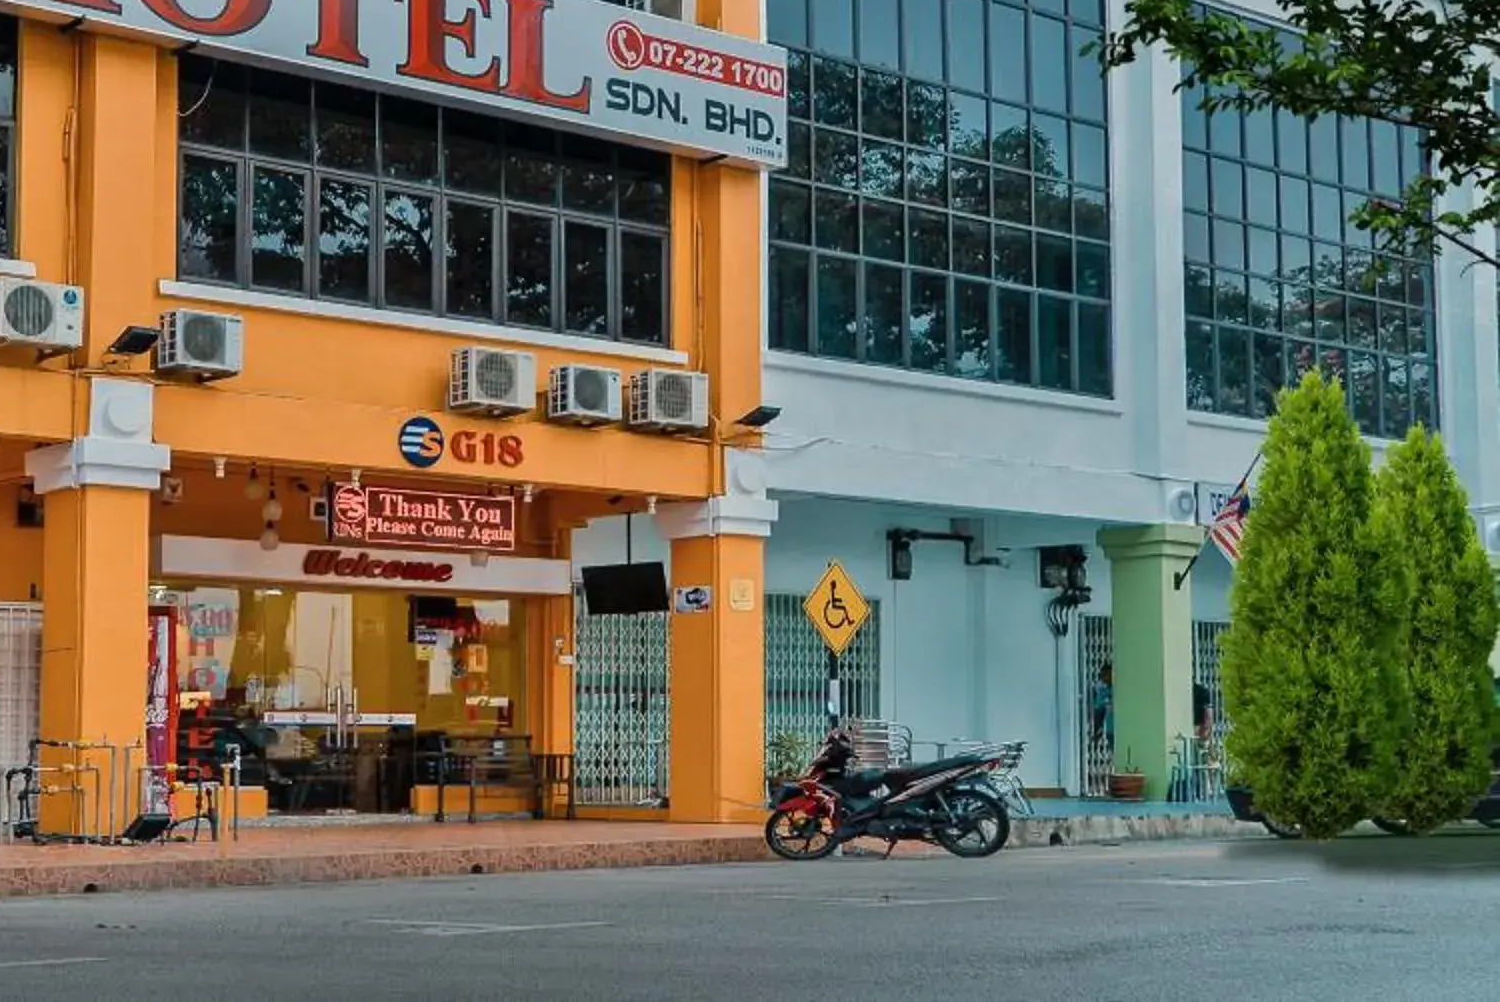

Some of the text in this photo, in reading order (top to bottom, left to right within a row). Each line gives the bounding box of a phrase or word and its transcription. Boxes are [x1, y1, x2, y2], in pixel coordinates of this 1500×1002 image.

[648, 40, 783, 93] 07-222 1700
[605, 77, 782, 146] SDN. BHD.
[450, 429, 525, 468] G18
[379, 493, 501, 524] Thank You
[367, 516, 513, 545] Please Come Again
[303, 549, 454, 582] Welcome
